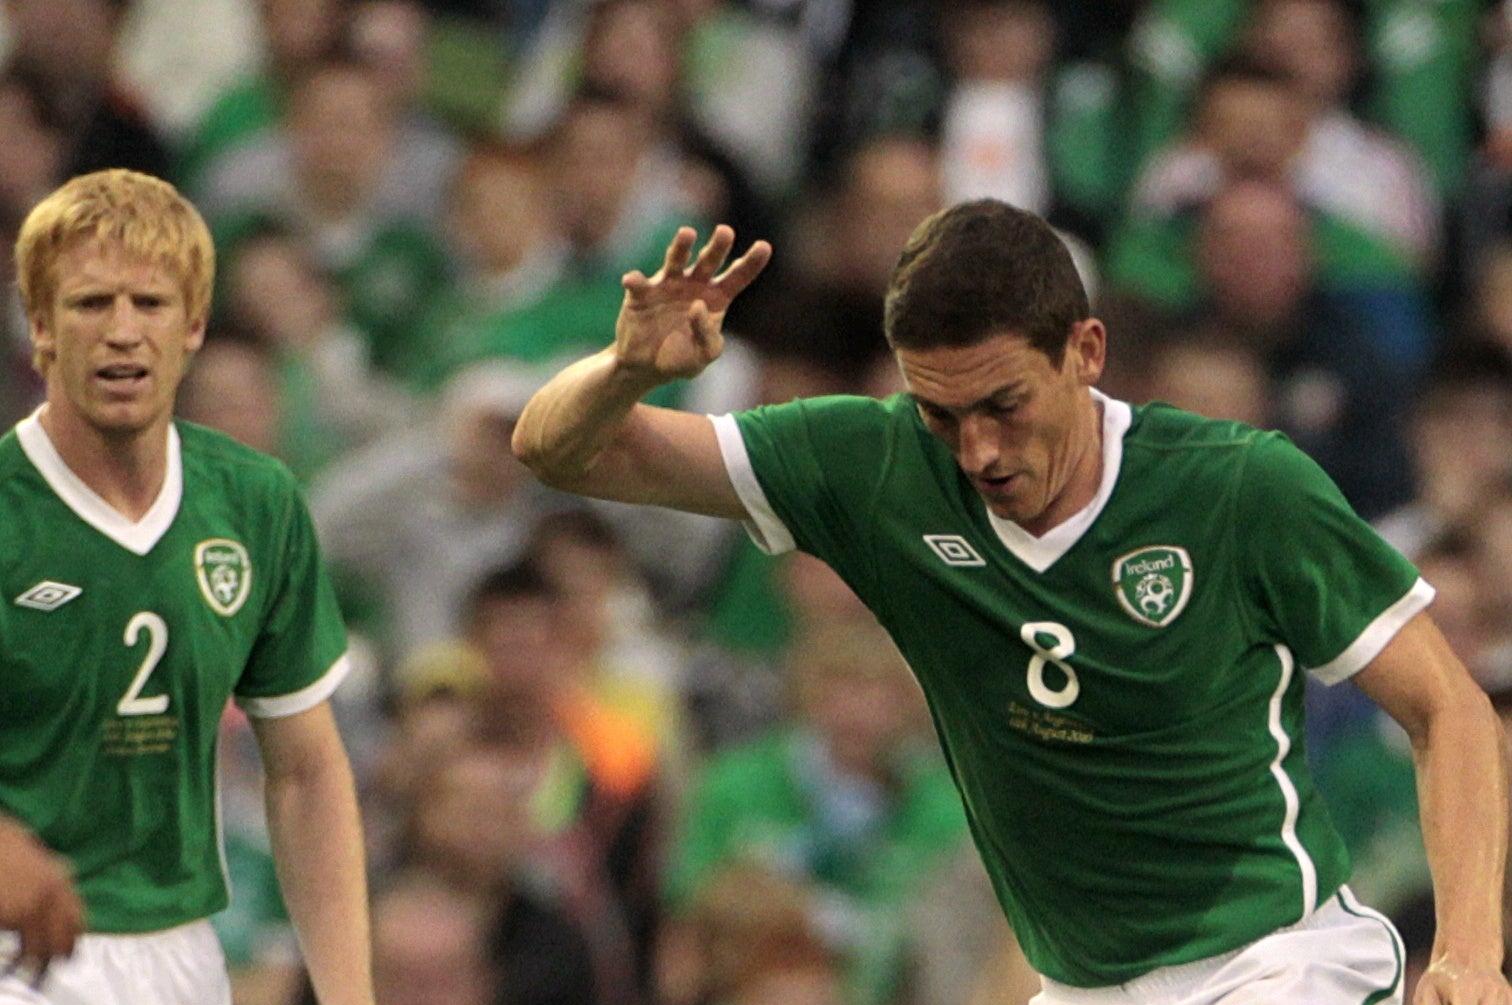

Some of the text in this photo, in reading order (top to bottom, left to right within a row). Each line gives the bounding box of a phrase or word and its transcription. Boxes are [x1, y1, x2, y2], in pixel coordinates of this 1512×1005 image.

[1125, 554, 1174, 576] Ireland
[117, 611, 169, 715] 2
[1020, 621, 1080, 709] 8
